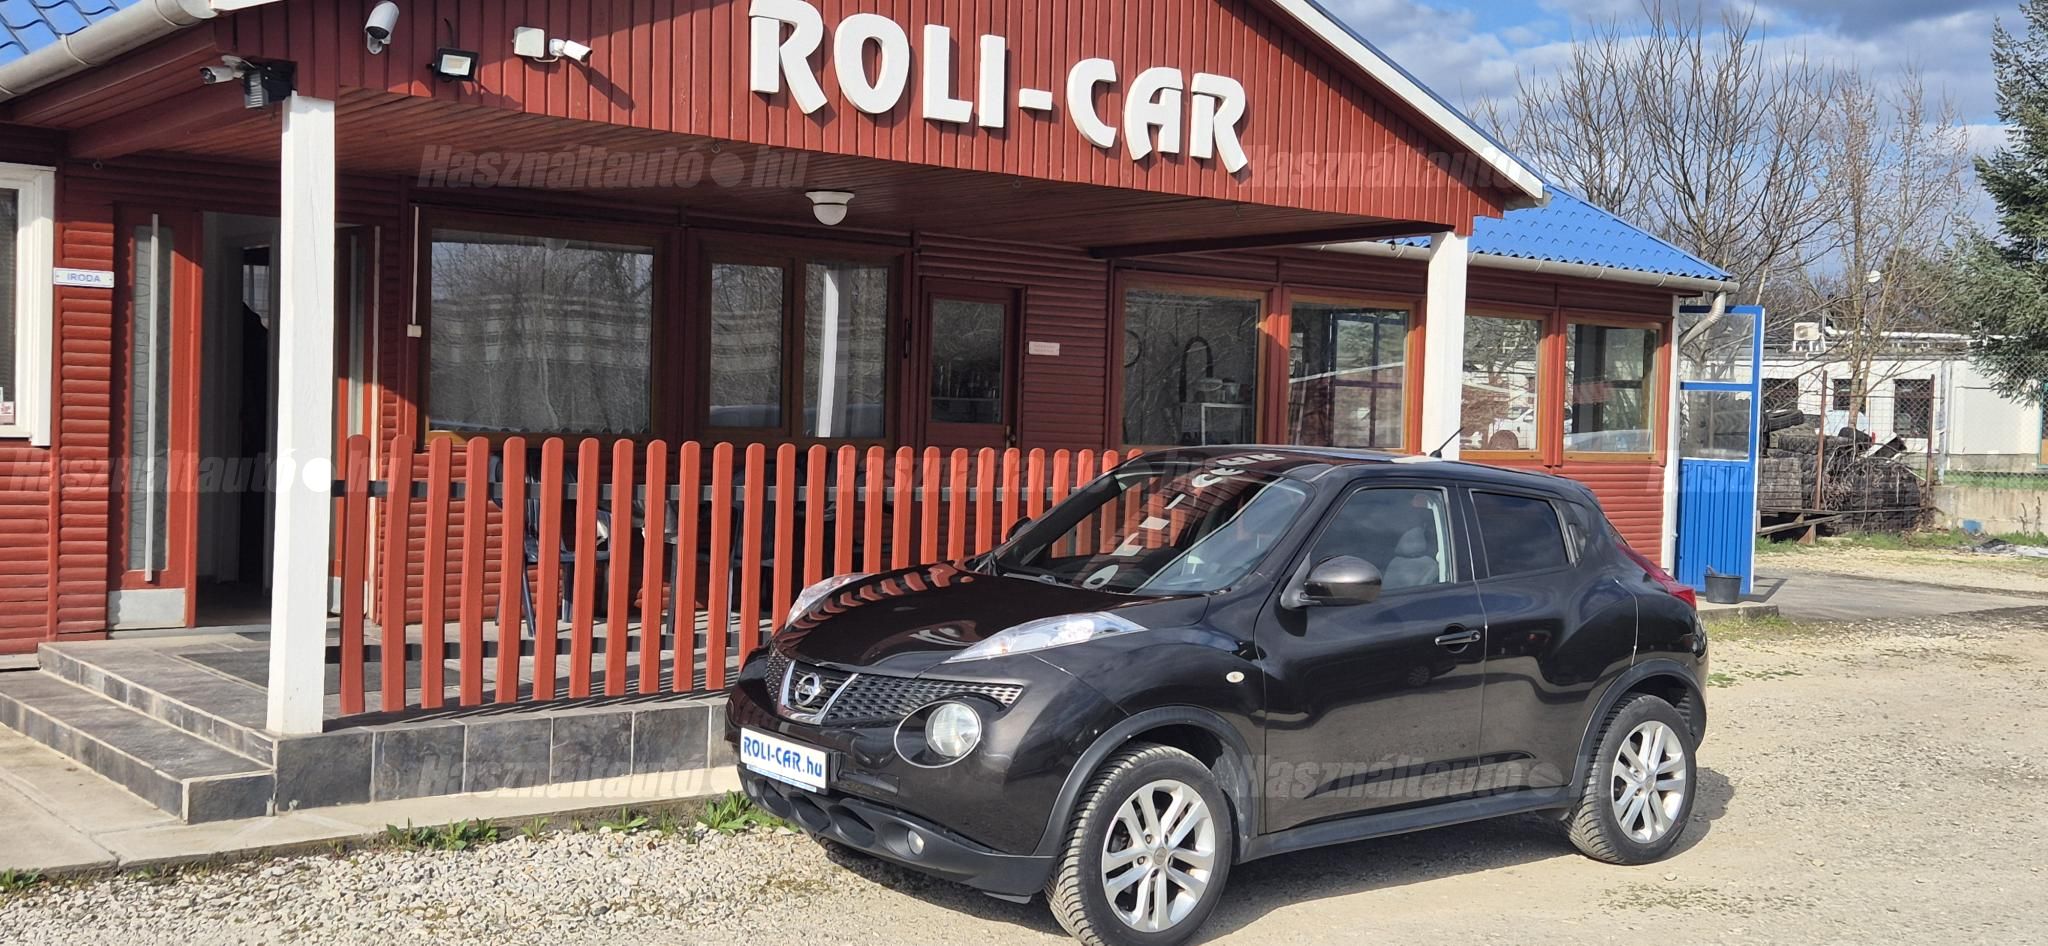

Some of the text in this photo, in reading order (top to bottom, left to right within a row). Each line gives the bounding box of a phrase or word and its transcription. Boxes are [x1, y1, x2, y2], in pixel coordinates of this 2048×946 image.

[749, 0, 1249, 173] ROLI-CAR
[67, 273, 101, 282] IRODA
[744, 736, 822, 777] ROLI-CAR.hu
